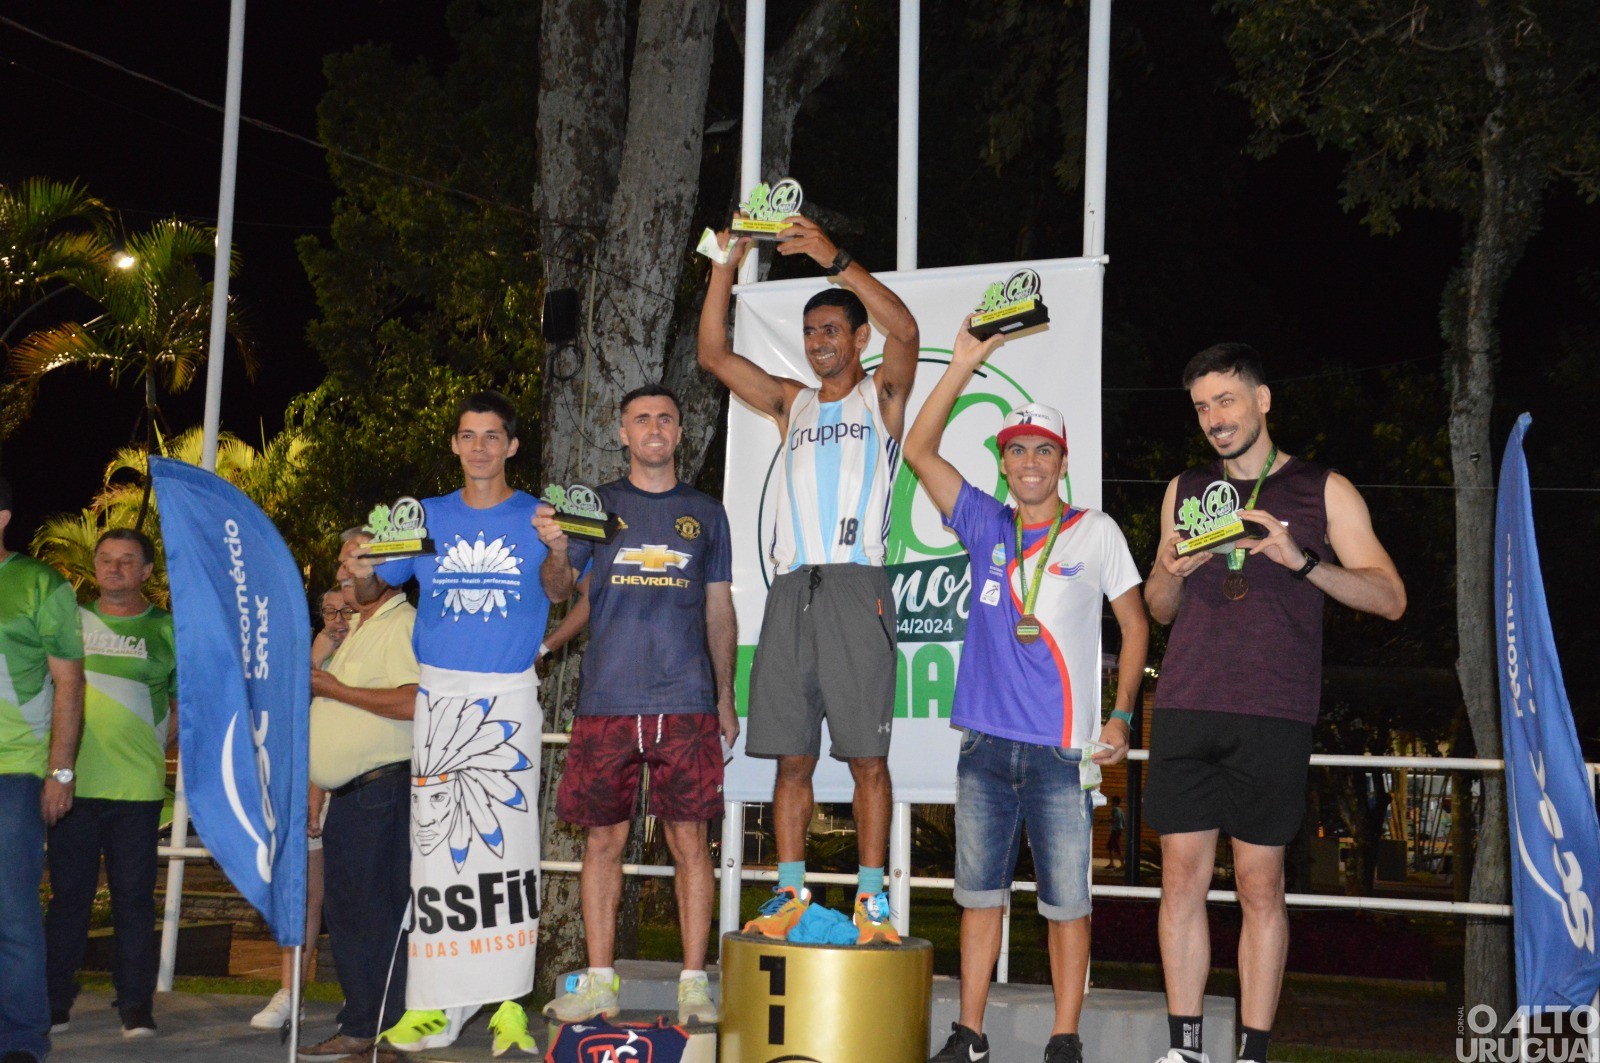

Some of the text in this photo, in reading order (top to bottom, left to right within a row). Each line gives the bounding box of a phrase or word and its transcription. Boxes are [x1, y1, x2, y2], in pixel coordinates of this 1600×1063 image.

[791, 422, 871, 451] Gruppen
[839, 517, 859, 546] 18
[483, 578, 520, 586] performance
[611, 575, 690, 588] CHEVROLET
[84, 630, 147, 652] ÚSTICA
[425, 941, 458, 958] DAS
